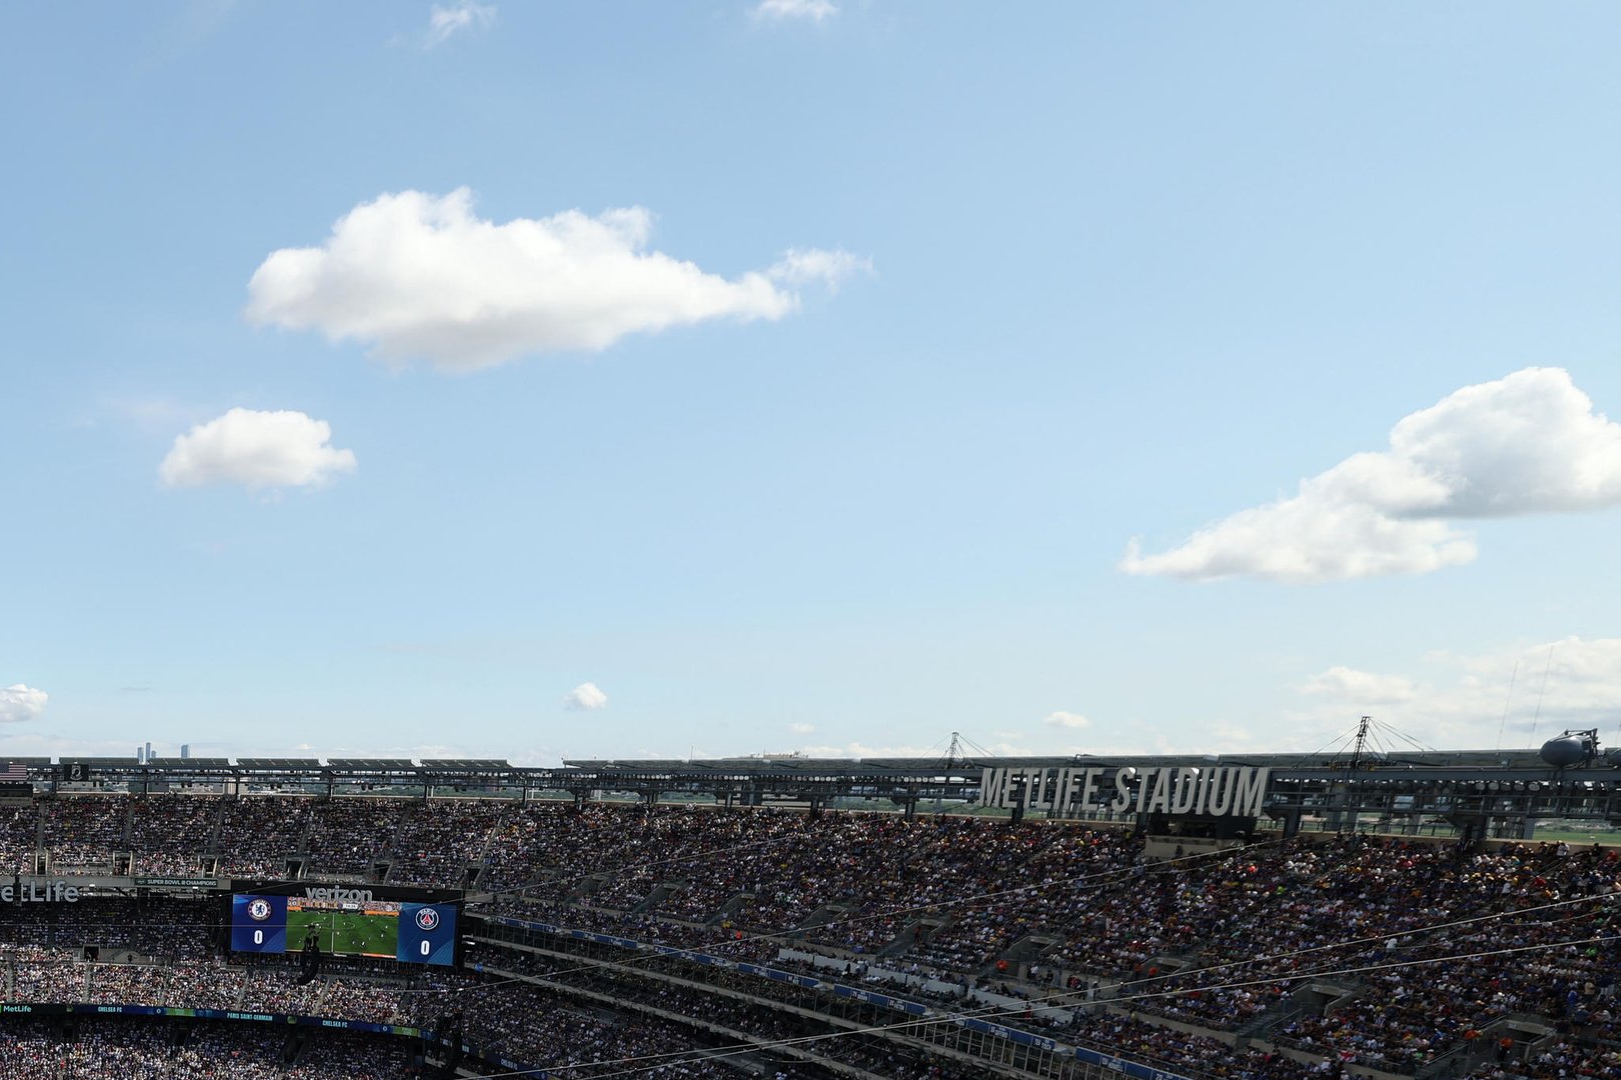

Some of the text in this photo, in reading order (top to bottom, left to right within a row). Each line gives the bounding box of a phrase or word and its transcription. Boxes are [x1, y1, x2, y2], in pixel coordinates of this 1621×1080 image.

[978, 766, 1270, 817] METLIFE STADIUM
[304, 885, 373, 902] verizon
[253, 930, 263, 945] 0
[420, 940, 430, 956] 0
[3, 1005, 32, 1013] MetLife
[240, 1013, 273, 1021] SAINT-GERMAIN
